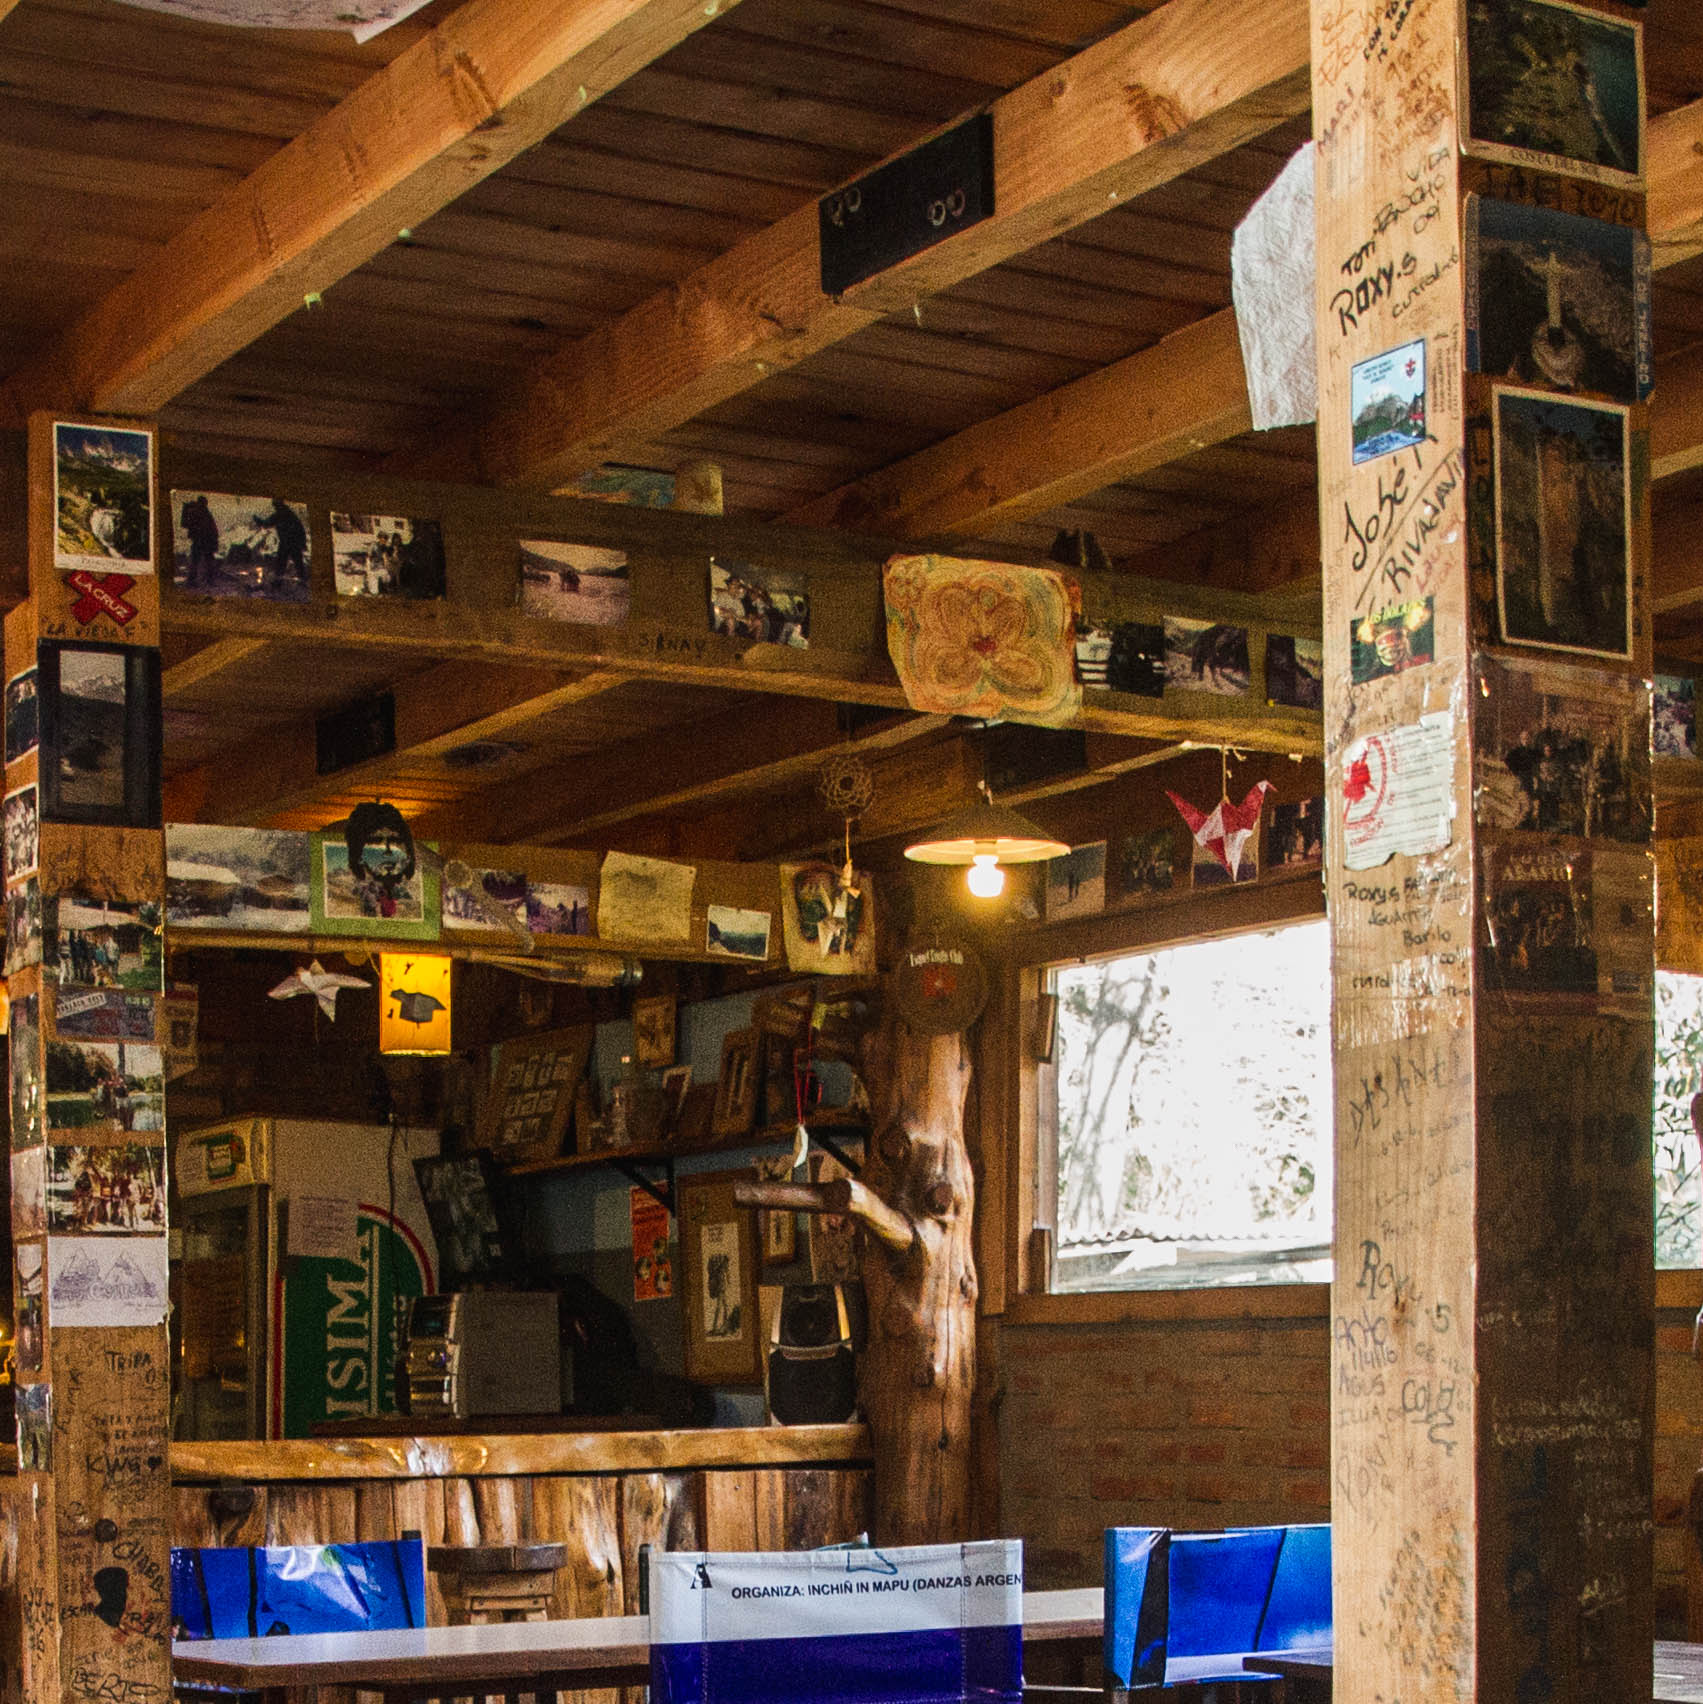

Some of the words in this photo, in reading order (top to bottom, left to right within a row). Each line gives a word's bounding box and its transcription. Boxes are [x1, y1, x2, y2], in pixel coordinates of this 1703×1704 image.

[730, 1584, 805, 1601] ORGANIZA:
[807, 1580, 853, 1597] INCHIÑ
[855, 1582, 871, 1595] IN
[872, 1579, 910, 1595] MAPU
[911, 1575, 972, 1594] (DANZAS
